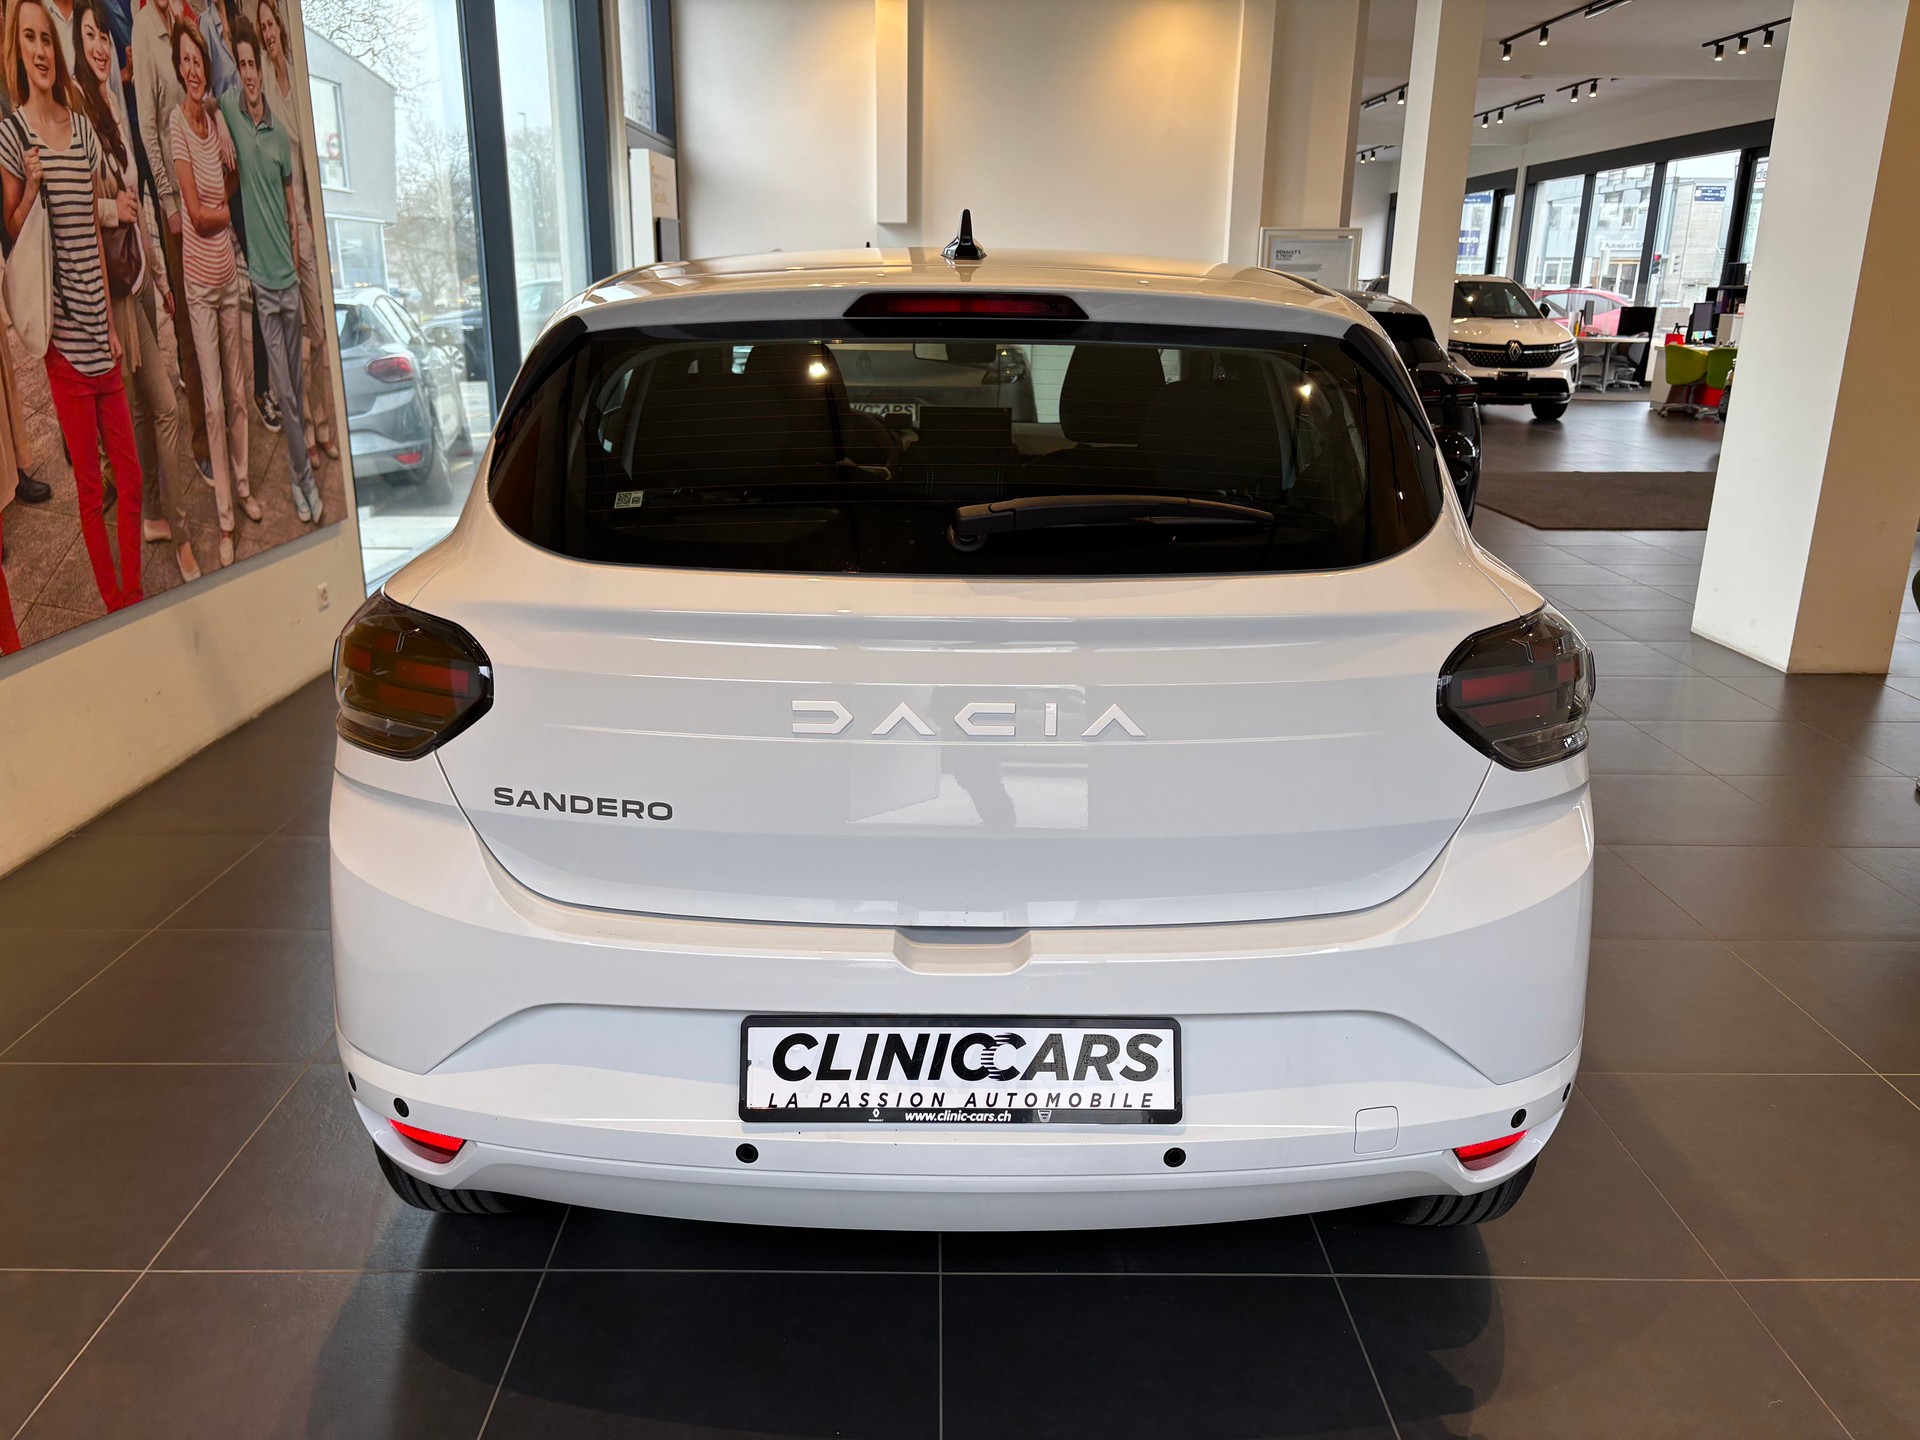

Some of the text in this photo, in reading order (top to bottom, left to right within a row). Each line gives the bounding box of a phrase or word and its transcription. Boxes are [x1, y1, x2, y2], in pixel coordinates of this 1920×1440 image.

[792, 700, 1146, 736] DACIA
[494, 786, 673, 821] SANDERO
[768, 1092, 1154, 1108] LA PASSION AUTOMOBILE
[905, 1109, 1012, 1122] www.clinic-cars.ch
